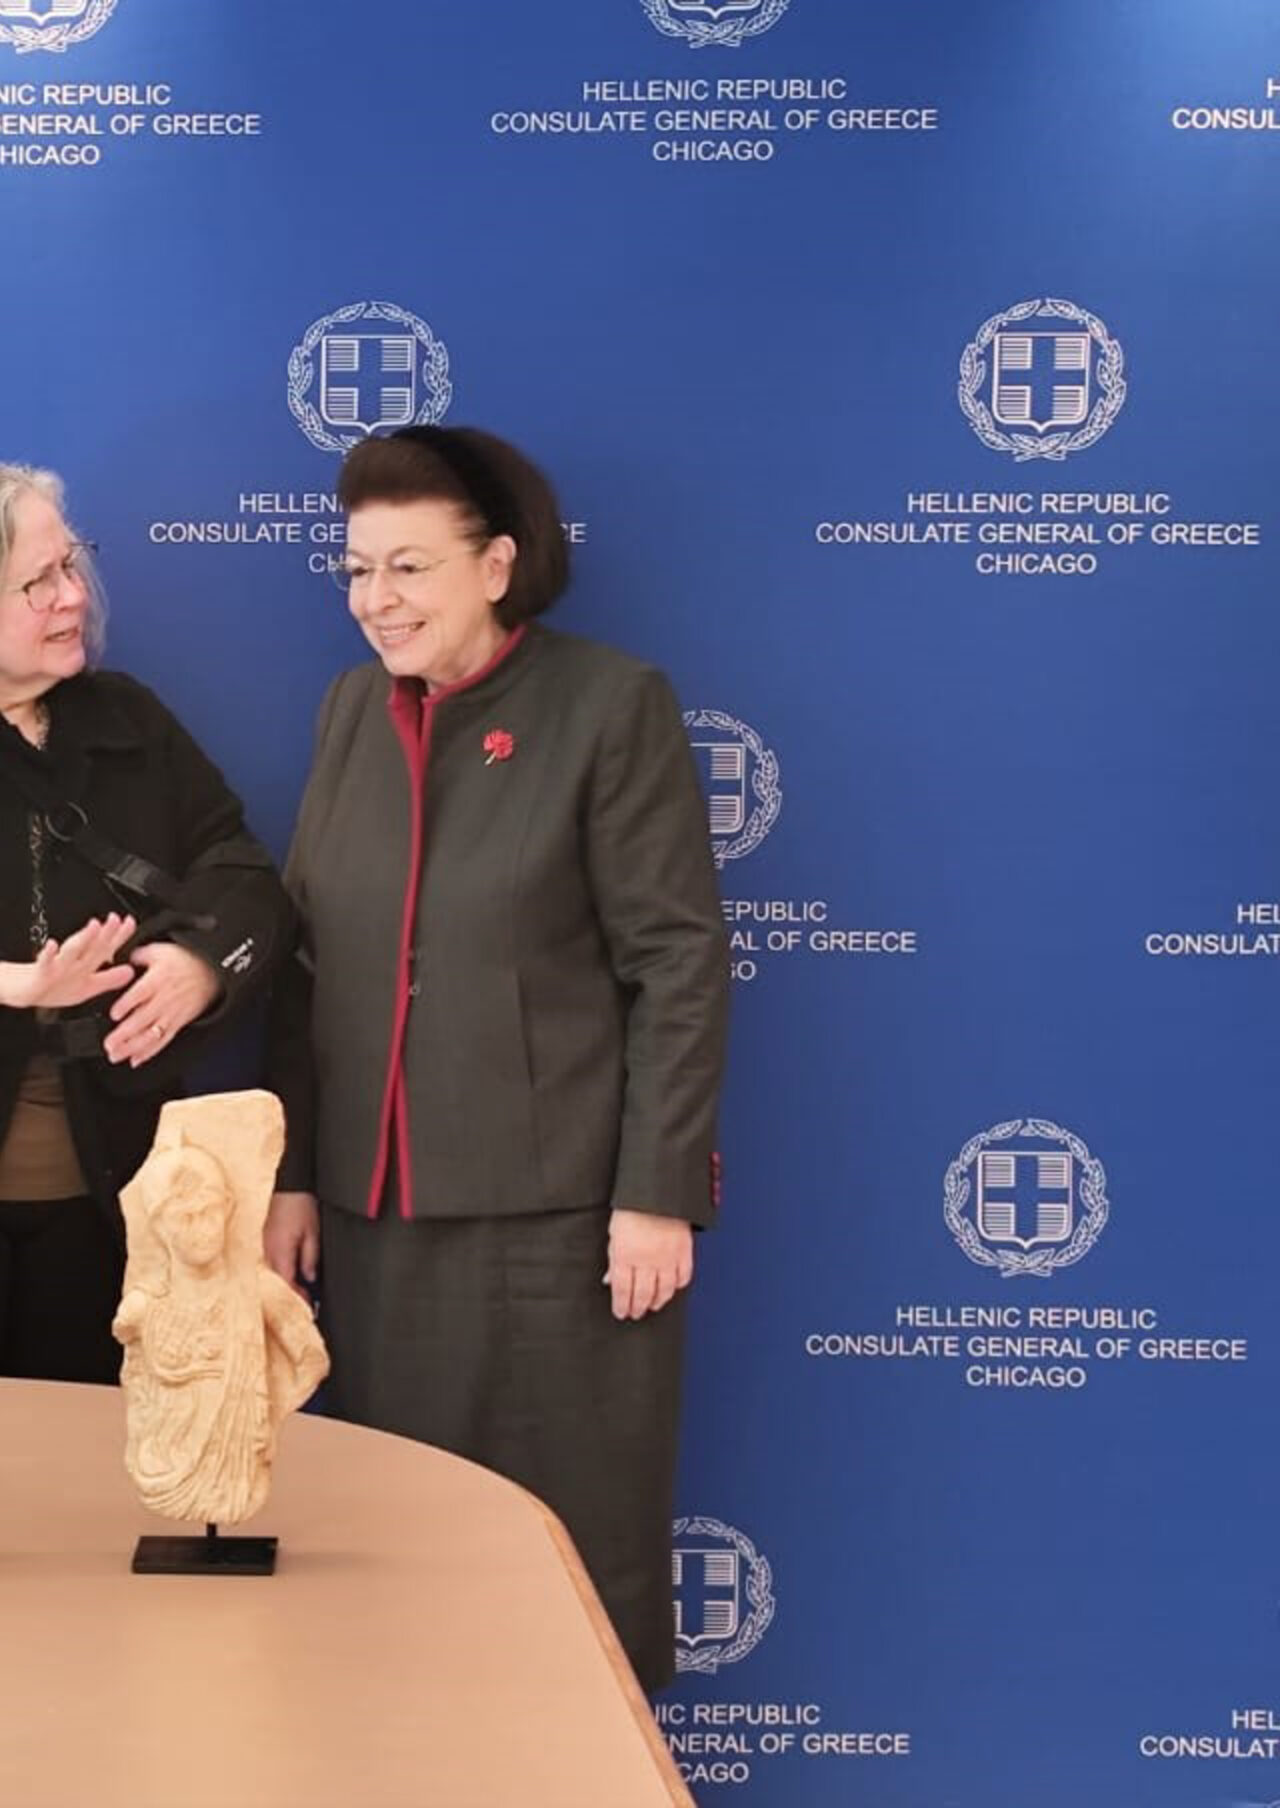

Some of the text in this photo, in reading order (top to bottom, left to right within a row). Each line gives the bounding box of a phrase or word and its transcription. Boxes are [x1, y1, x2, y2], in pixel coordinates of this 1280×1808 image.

[43, 84, 171, 105] REPUBLIC
[583, 78, 847, 102] HELLENIC REPUBLIC
[109, 113, 146, 135] OF
[152, 114, 260, 135] GREECE
[490, 108, 938, 133] CONSULATE GENERAL OF GREECE
[1172, 107, 1280, 130] CONSUL
[652, 139, 774, 161] CHICAGO
[907, 492, 1170, 515] HELLENIC REPUBLIC
[149, 522, 302, 543] CONSULATE
[815, 522, 1260, 545] CONSULATE GENERAL OF GREECE
[975, 552, 1097, 575] CHICAGO
[767, 930, 802, 951] OF
[809, 930, 917, 953] GREECE
[896, 1306, 1157, 1330] HELLENIC REPUBLIC
[805, 1334, 1247, 1361] CONSULATE GENERAL OF GREECE
[965, 1365, 1087, 1388] CHICAGO
[693, 1703, 821, 1726] REPUBLIC
[664, 1732, 910, 1755] NERAL OF GREECE
[1139, 1735, 1280, 1759] CONSULAT
